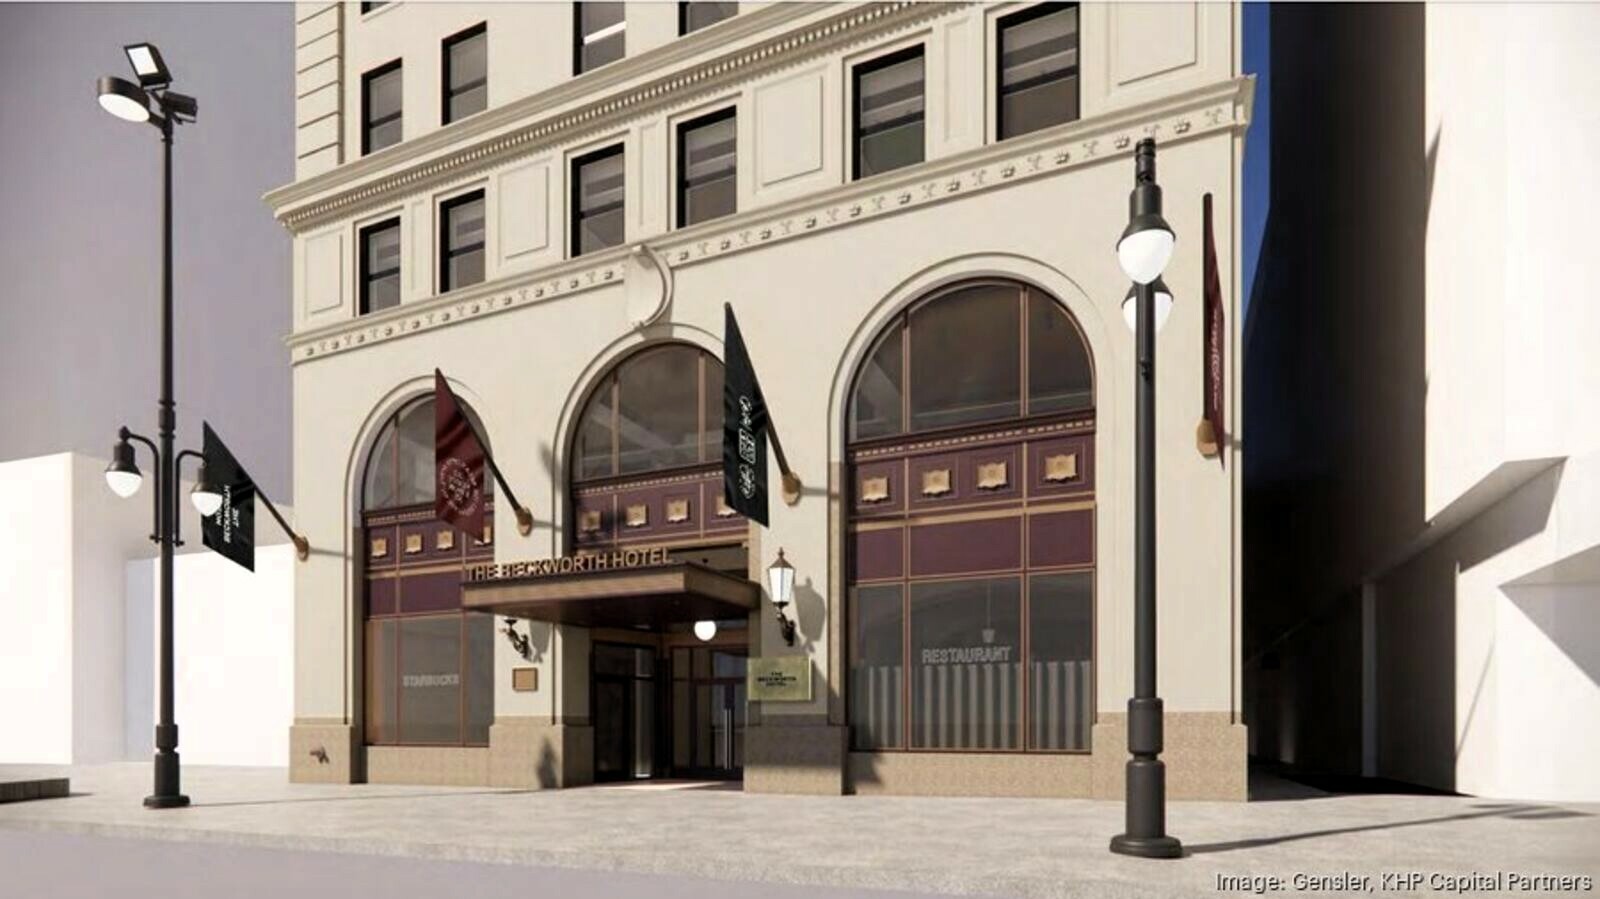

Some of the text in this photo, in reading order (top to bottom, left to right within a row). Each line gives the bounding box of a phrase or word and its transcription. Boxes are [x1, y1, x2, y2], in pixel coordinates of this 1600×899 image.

[466, 547, 673, 581] THE BECKWORTH HOTEL
[922, 646, 1012, 664] RESTAURANT
[403, 674, 459, 687] STARBUCKS
